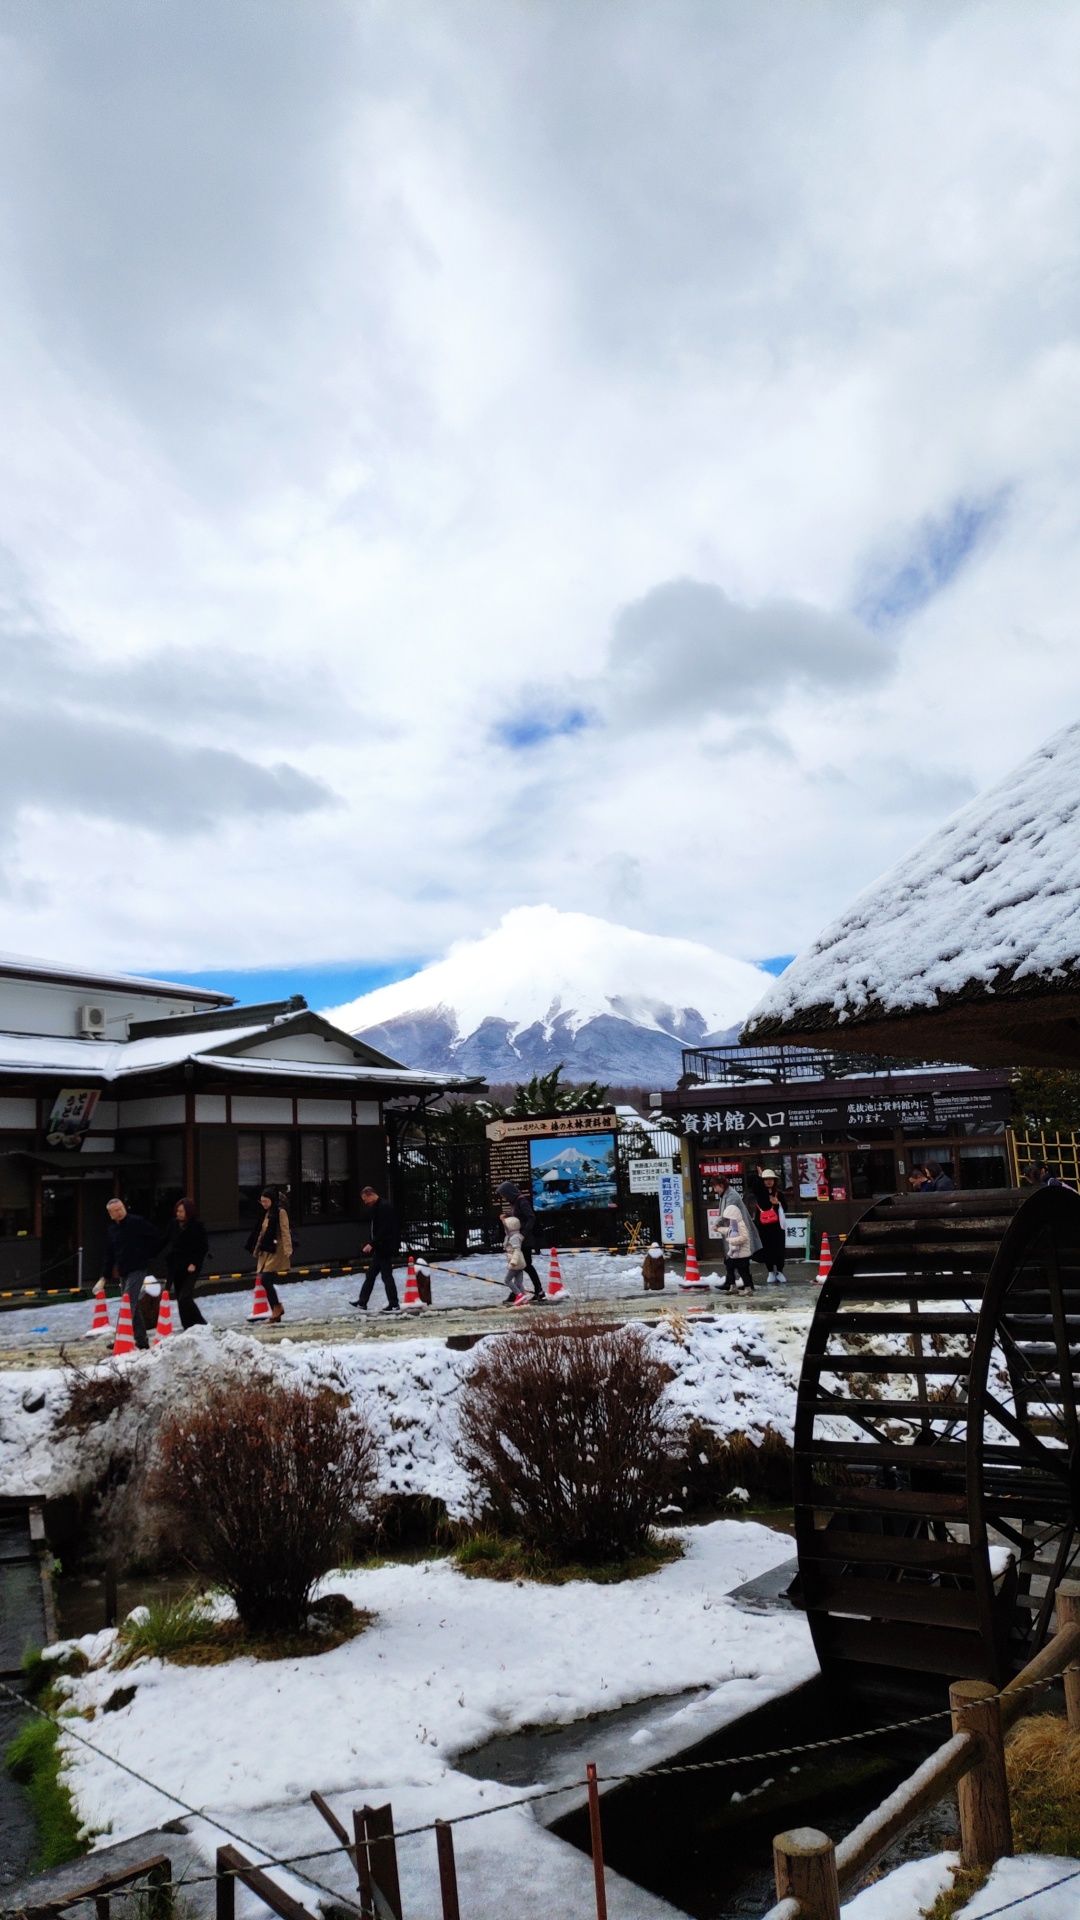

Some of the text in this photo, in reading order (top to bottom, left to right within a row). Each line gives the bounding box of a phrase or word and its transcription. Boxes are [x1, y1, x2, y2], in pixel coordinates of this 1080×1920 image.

[788, 1108, 809, 1116] Entrance
[847, 1100, 929, 1113] 底抜池は資料館内に
[681, 1110, 785, 1135] 資料館入口
[848, 1113, 885, 1124] あります。
[703, 1164, 739, 1173] 資料館受付
